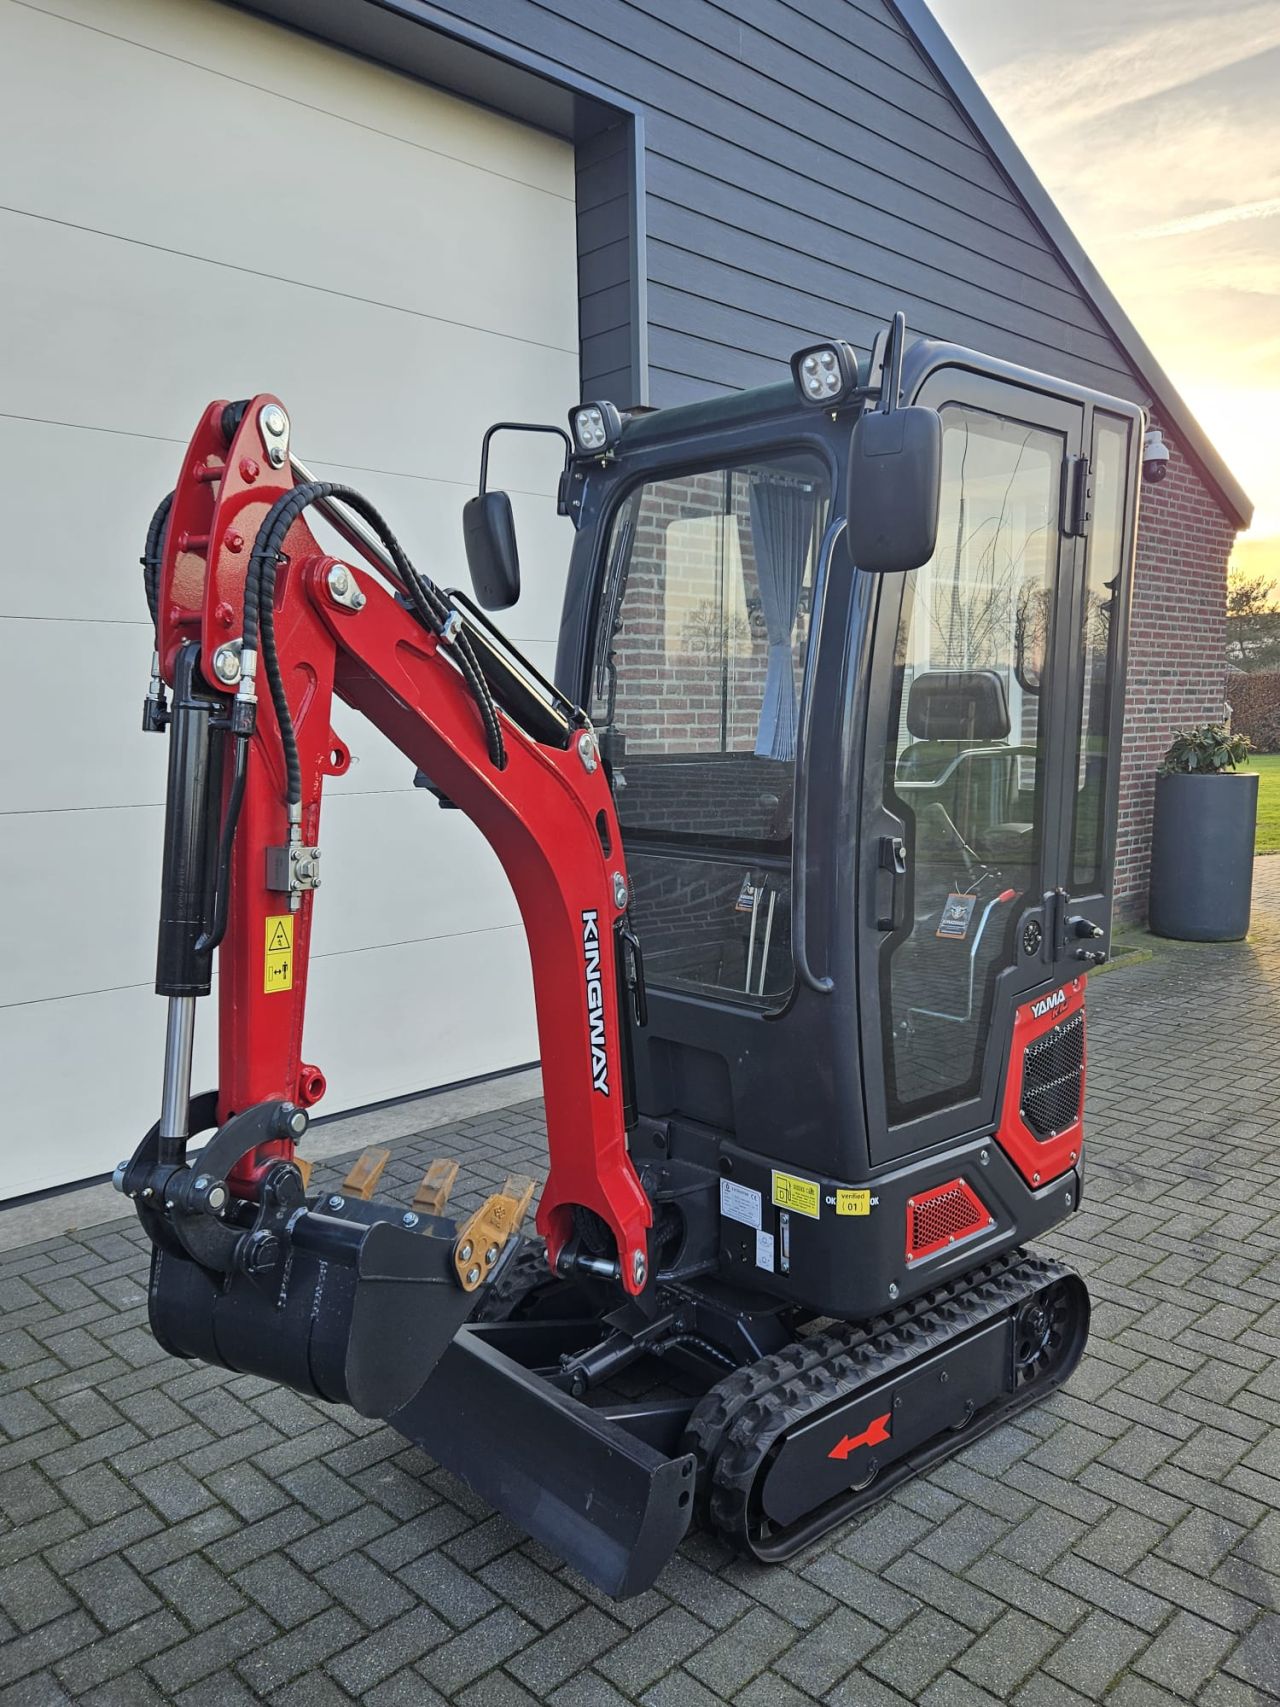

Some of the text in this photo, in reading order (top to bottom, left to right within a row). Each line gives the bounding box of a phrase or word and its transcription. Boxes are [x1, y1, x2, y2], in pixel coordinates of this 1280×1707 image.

[581, 910, 610, 1096] KINGWAY
[1031, 989, 1066, 1018] YAMA
[825, 1196, 836, 1205] OK
[870, 1196, 880, 1206] OK
